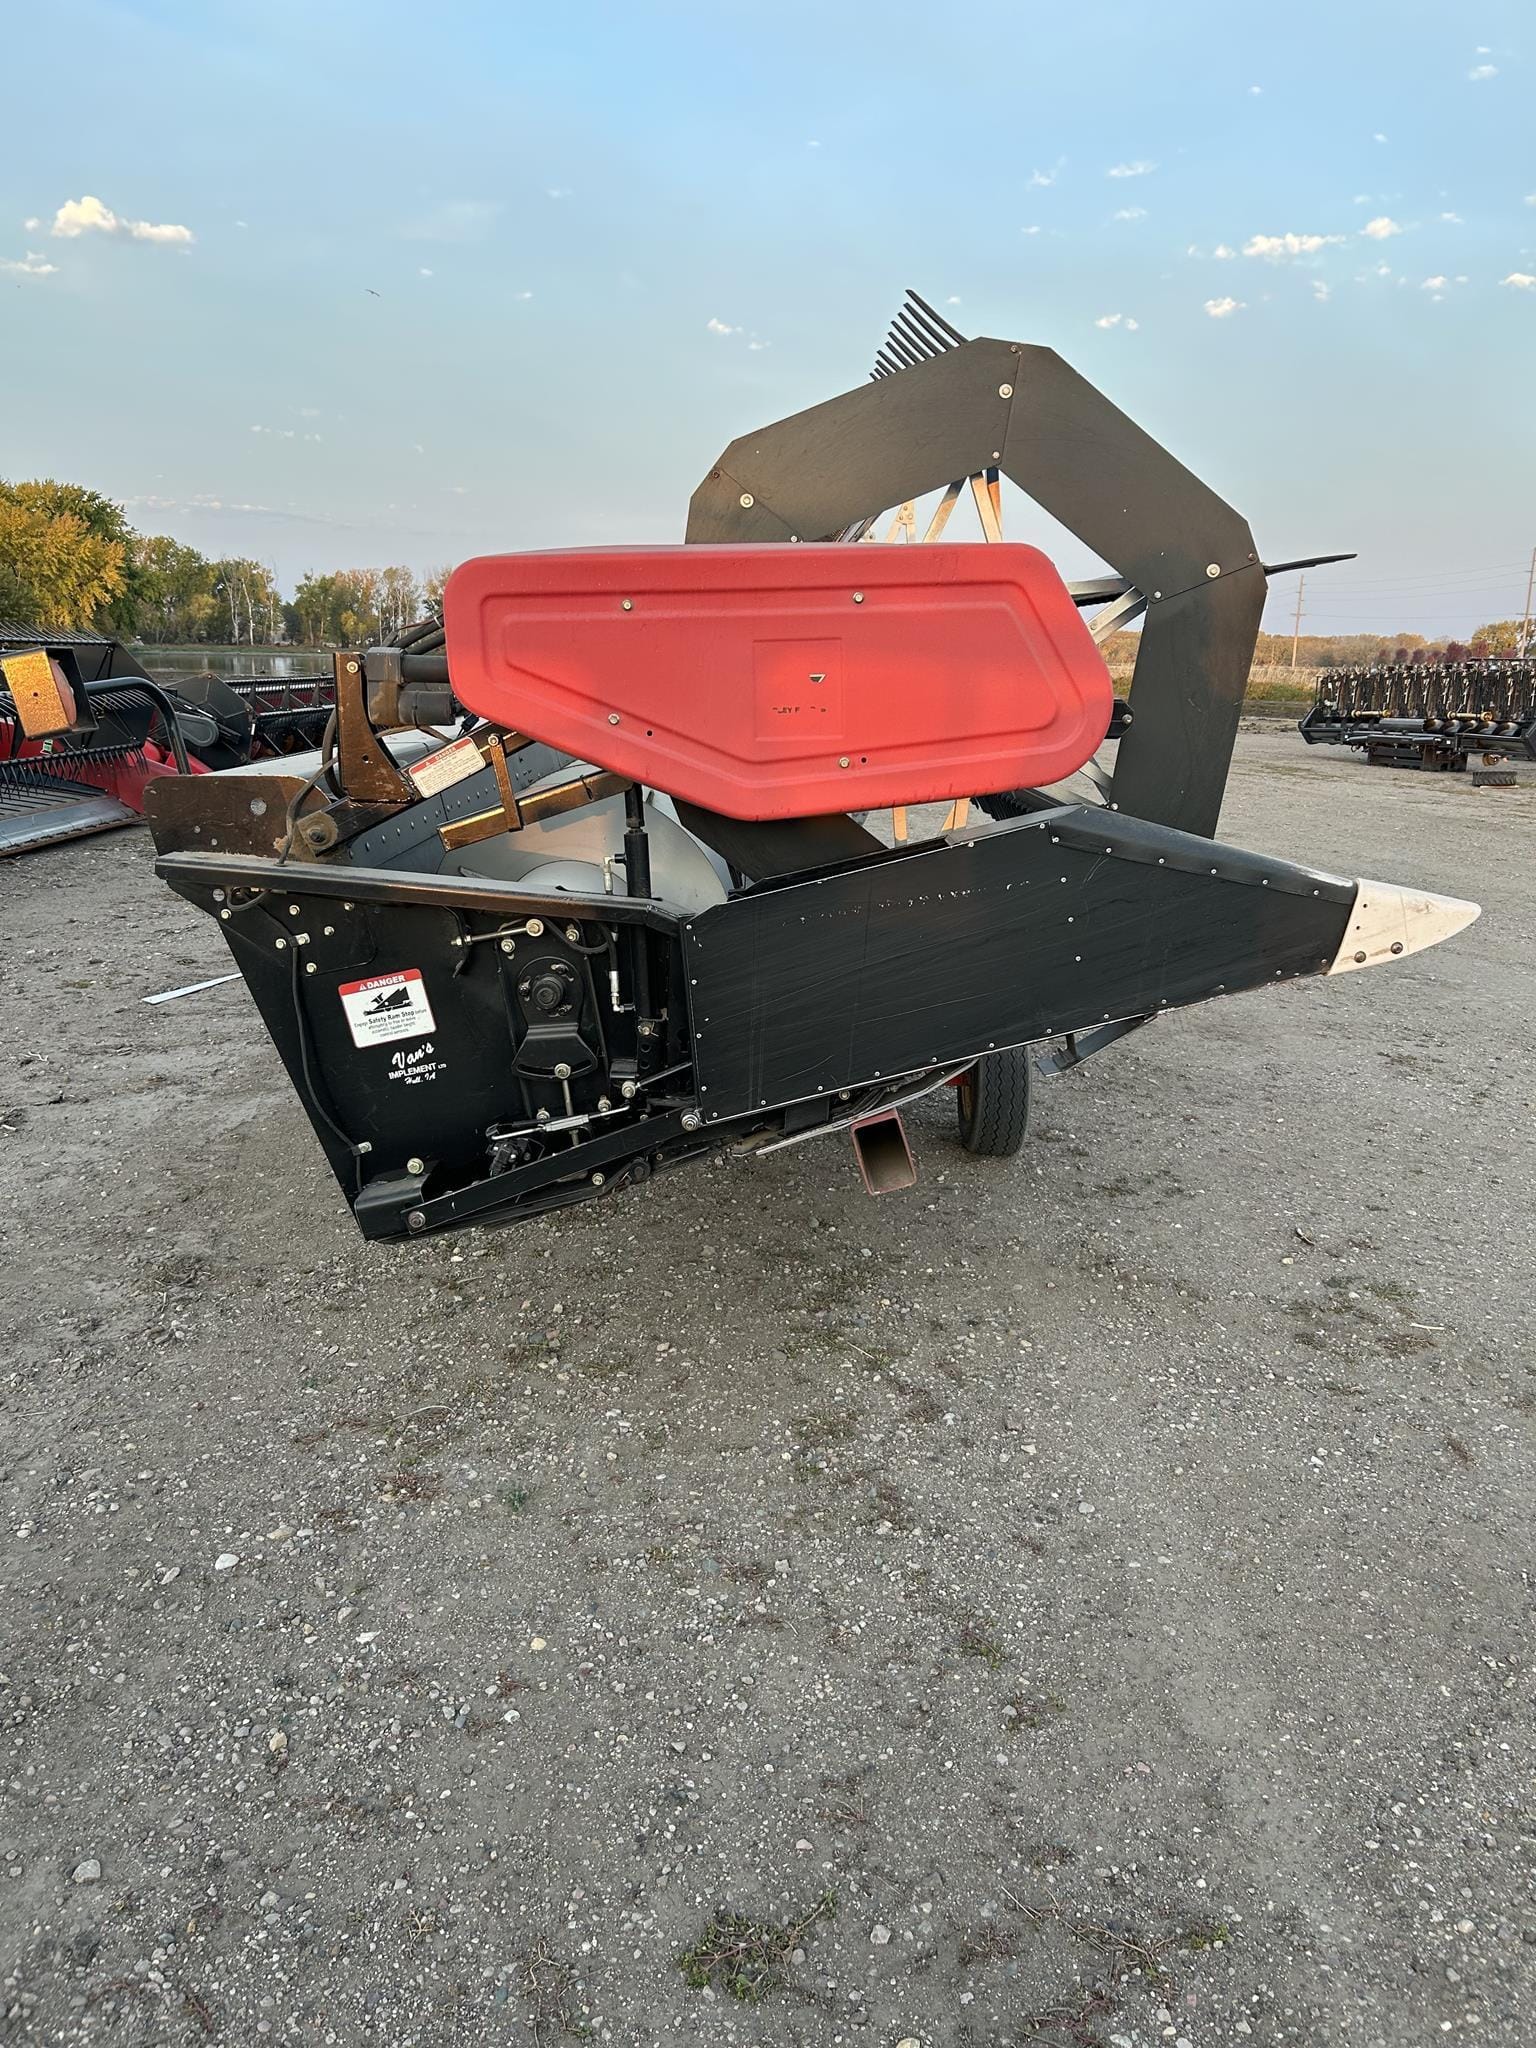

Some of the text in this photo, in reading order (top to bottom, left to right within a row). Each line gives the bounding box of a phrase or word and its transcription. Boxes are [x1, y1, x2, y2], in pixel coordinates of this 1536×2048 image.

[366, 974, 406, 989] DANGER
[368, 1015, 387, 1025] Safety
[387, 1012, 401, 1021] Ram
[401, 1010, 415, 1018] Stop
[391, 1041, 435, 1069] Van's
[388, 1062, 437, 1080] IMPLEMENT
[424, 1071, 436, 1081] IA
